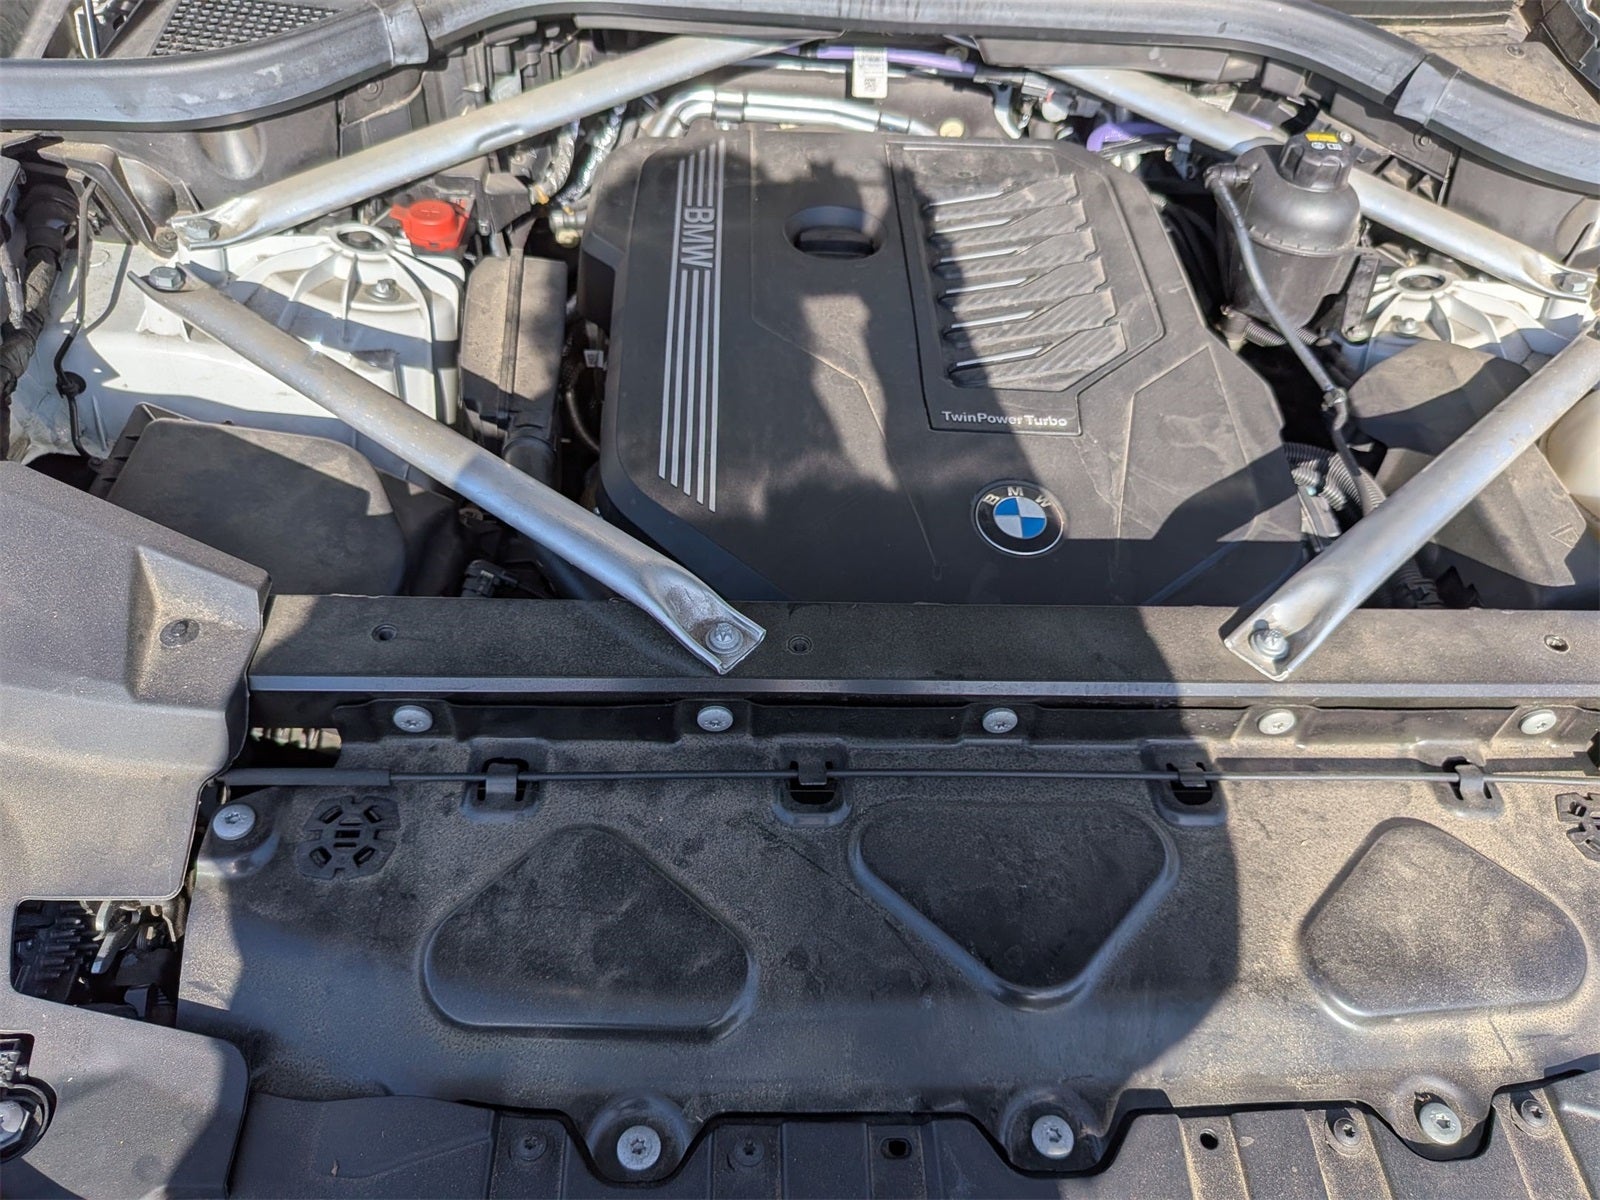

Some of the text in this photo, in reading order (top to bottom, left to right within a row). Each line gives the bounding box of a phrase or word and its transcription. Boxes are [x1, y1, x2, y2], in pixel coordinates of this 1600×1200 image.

[680, 208, 715, 268] BMW
[1024, 414, 1068, 427] Turbo
[983, 486, 1052, 508] BMW
